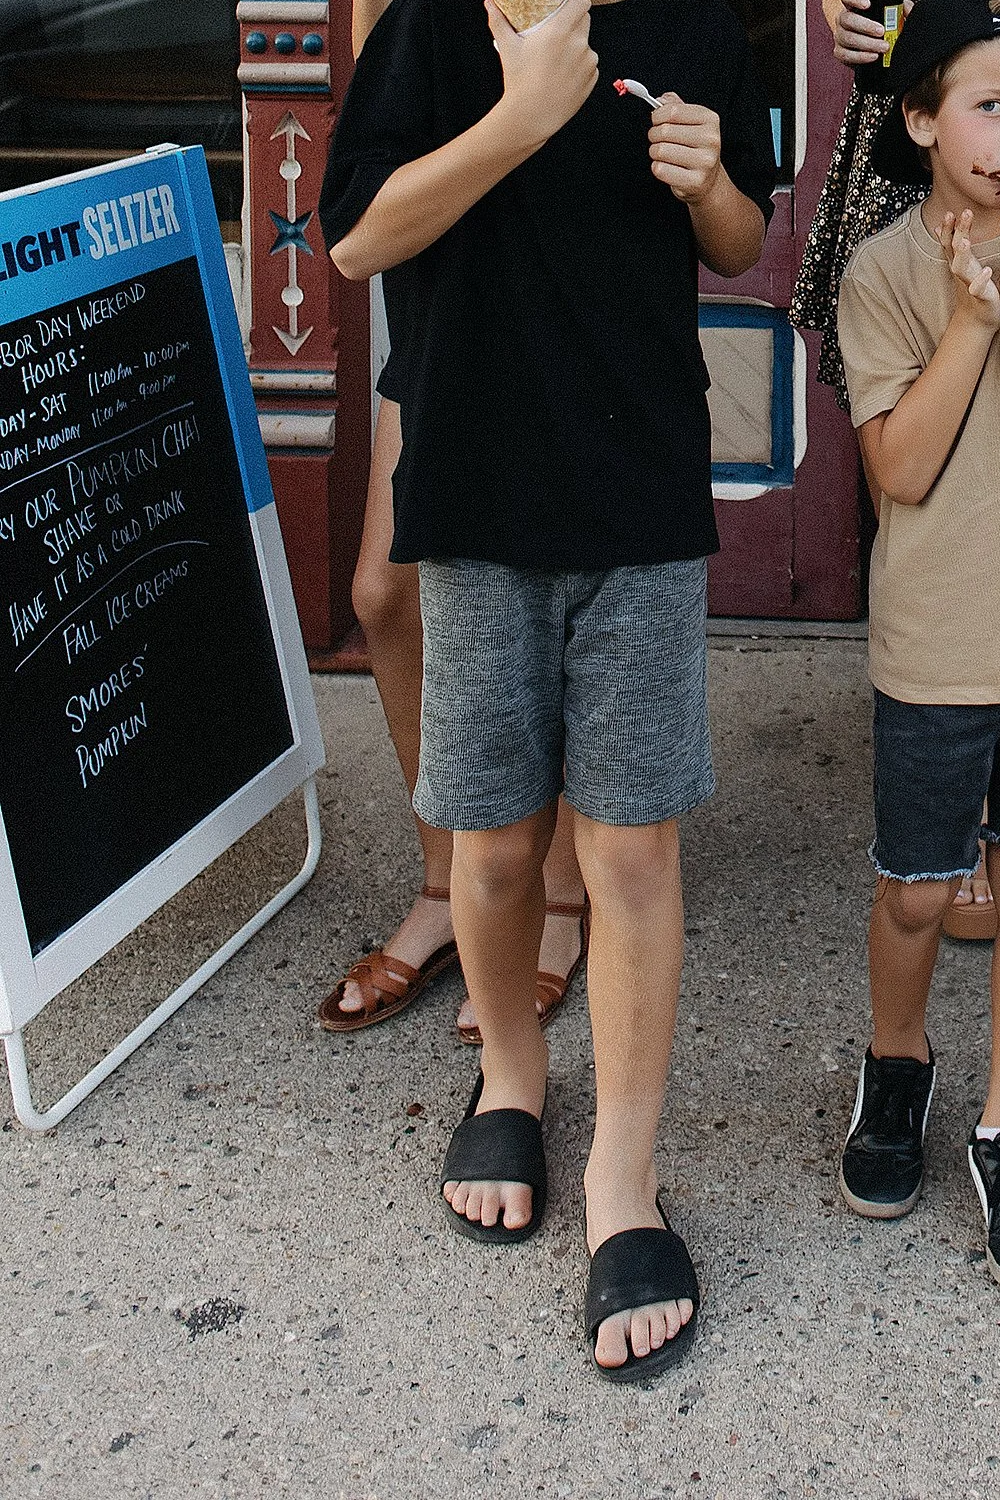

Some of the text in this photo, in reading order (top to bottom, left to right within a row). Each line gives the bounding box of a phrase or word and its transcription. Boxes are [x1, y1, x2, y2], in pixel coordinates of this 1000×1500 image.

[83, 184, 181, 260] SELTZER
[0, 283, 146, 369] BOR DAY WEEKEND
[21, 344, 85, 394] HOURS:
[25, 488, 61, 529] OUR
[66, 438, 158, 505] PUMPKIN
[9, 490, 186, 647] HAVE IT AS A COLD DRINK
[44, 493, 123, 564] SHAKE OR
[63, 560, 188, 664] FALL ICE CREAMS
[75, 702, 148, 788] PUMPKIN
